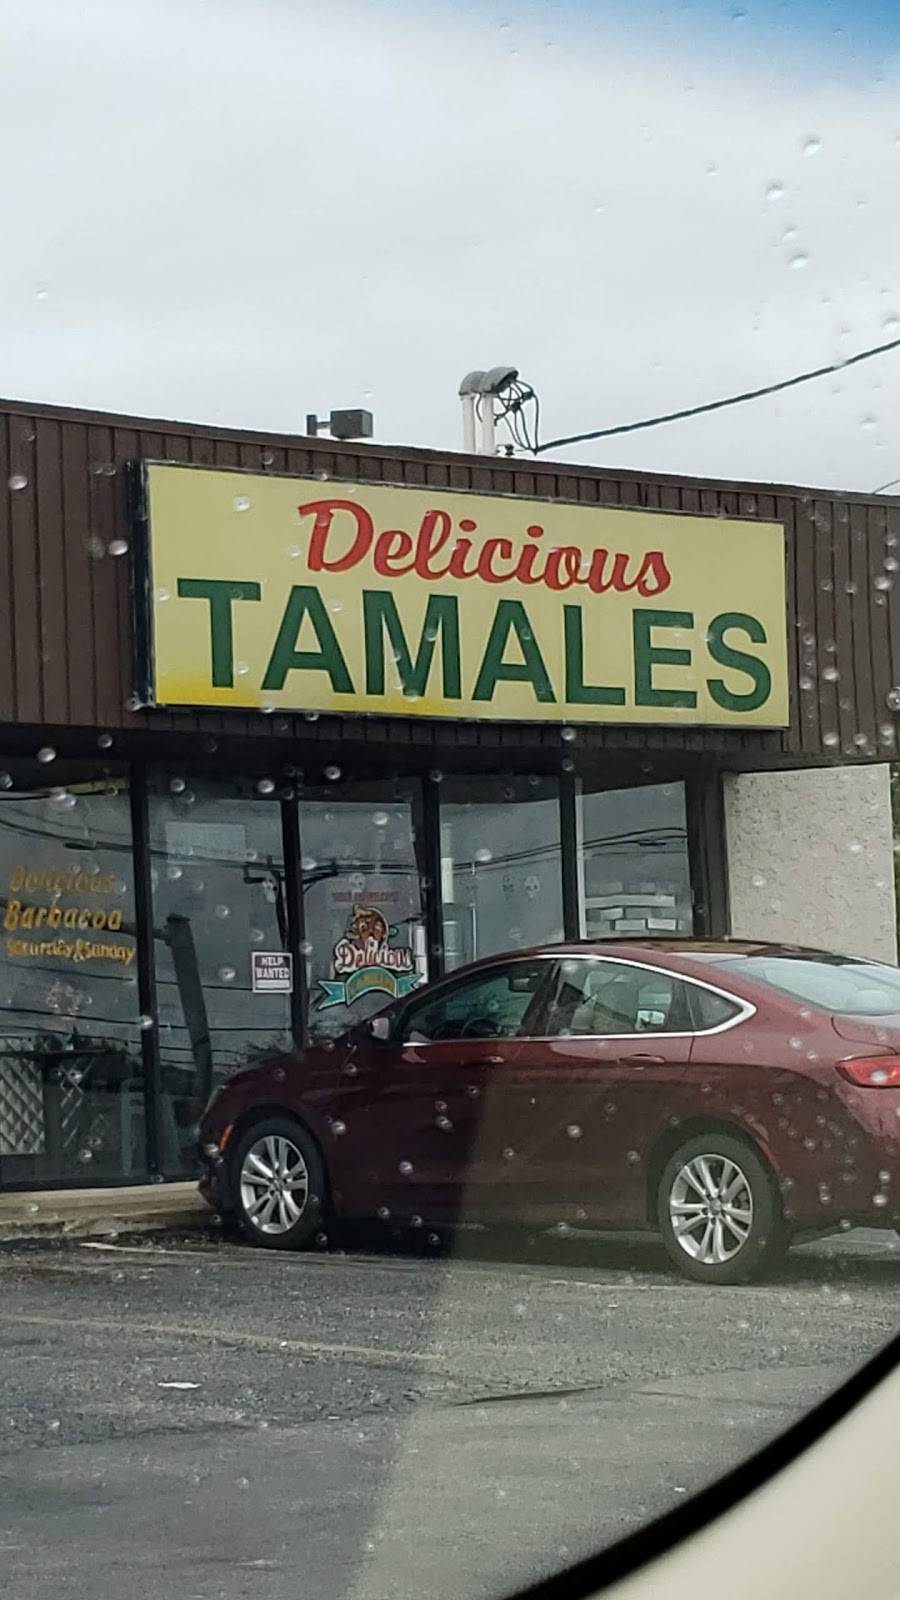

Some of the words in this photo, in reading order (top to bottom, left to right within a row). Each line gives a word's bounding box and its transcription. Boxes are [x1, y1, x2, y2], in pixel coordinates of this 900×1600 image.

[299, 499, 671, 597] Delicious
[177, 577, 772, 712] TAMALES
[3, 900, 121, 930] Barbacoa
[255, 967, 290, 979] WANTED
[261, 956, 284, 966] HELP
